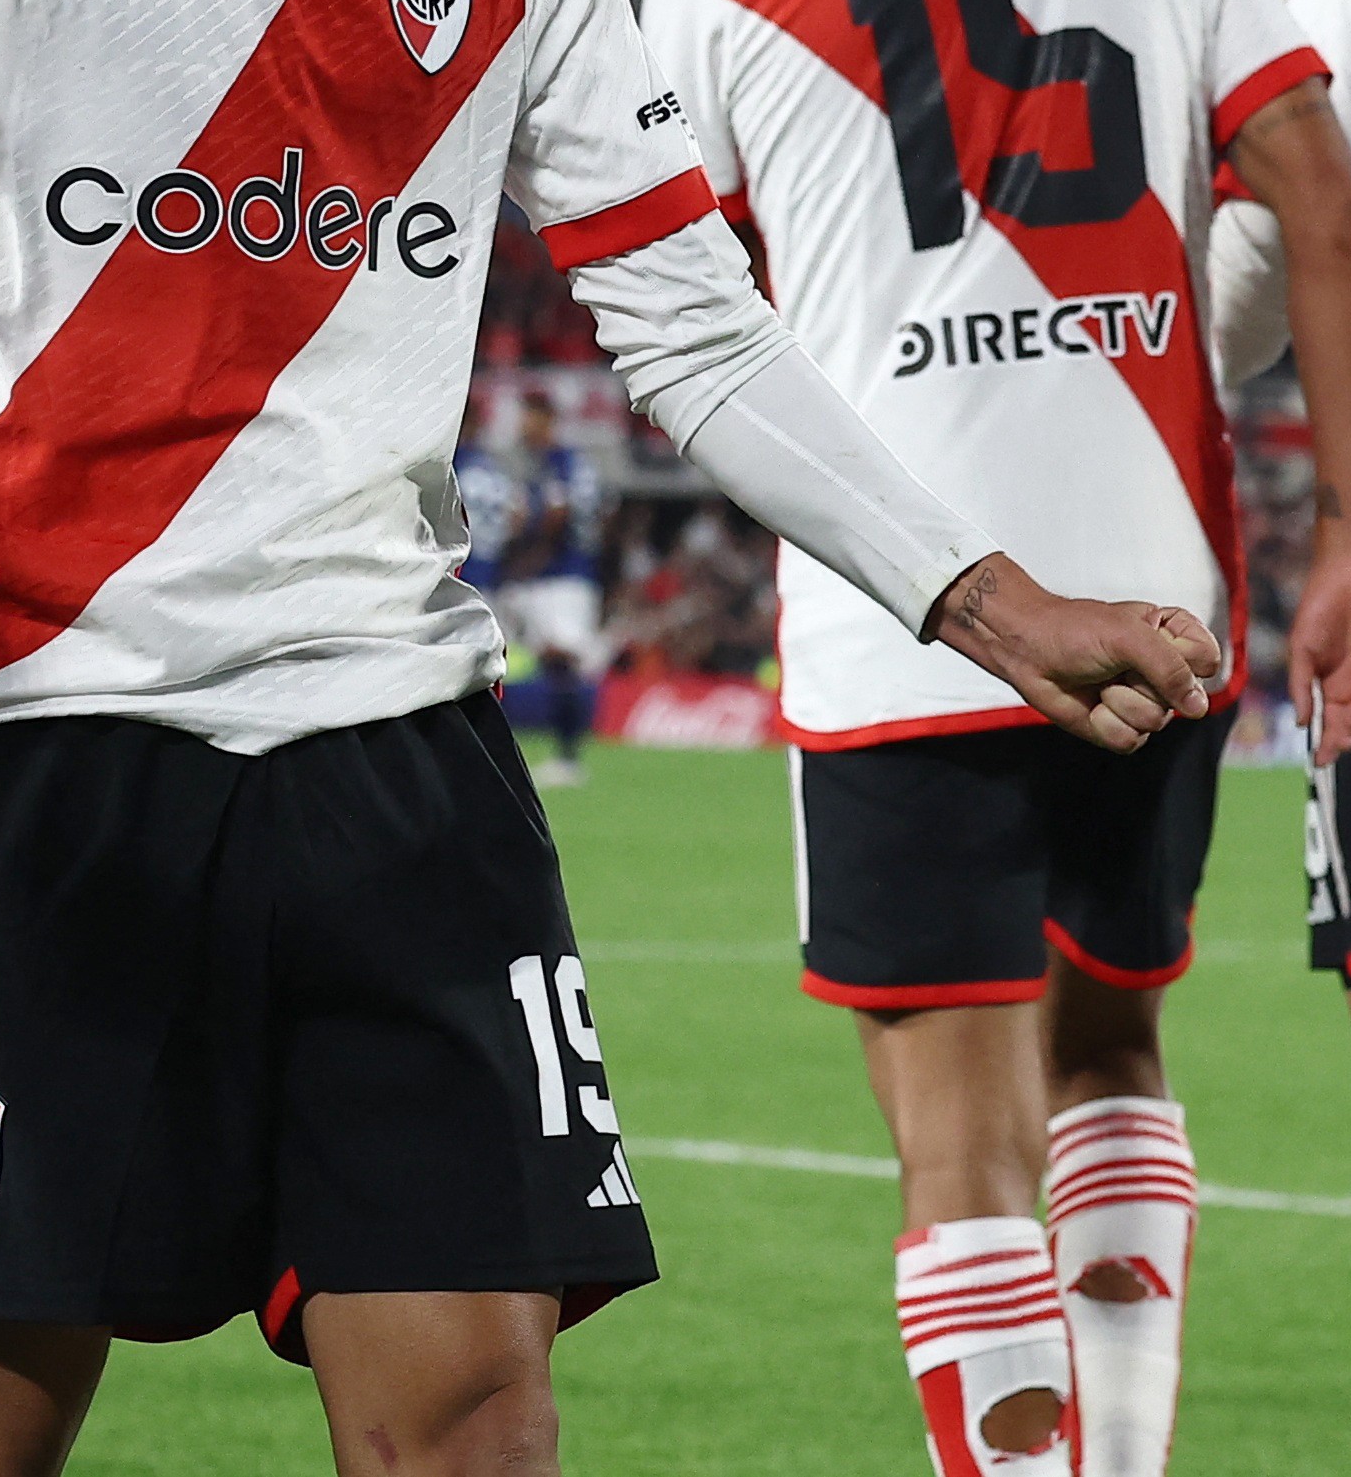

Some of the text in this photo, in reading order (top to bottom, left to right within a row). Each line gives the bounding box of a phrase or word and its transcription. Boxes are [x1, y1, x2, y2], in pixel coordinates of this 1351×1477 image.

[46, 147, 459, 279] codere
[893, 293, 1176, 379] DIRECTV
[508, 954, 624, 1137] 19
